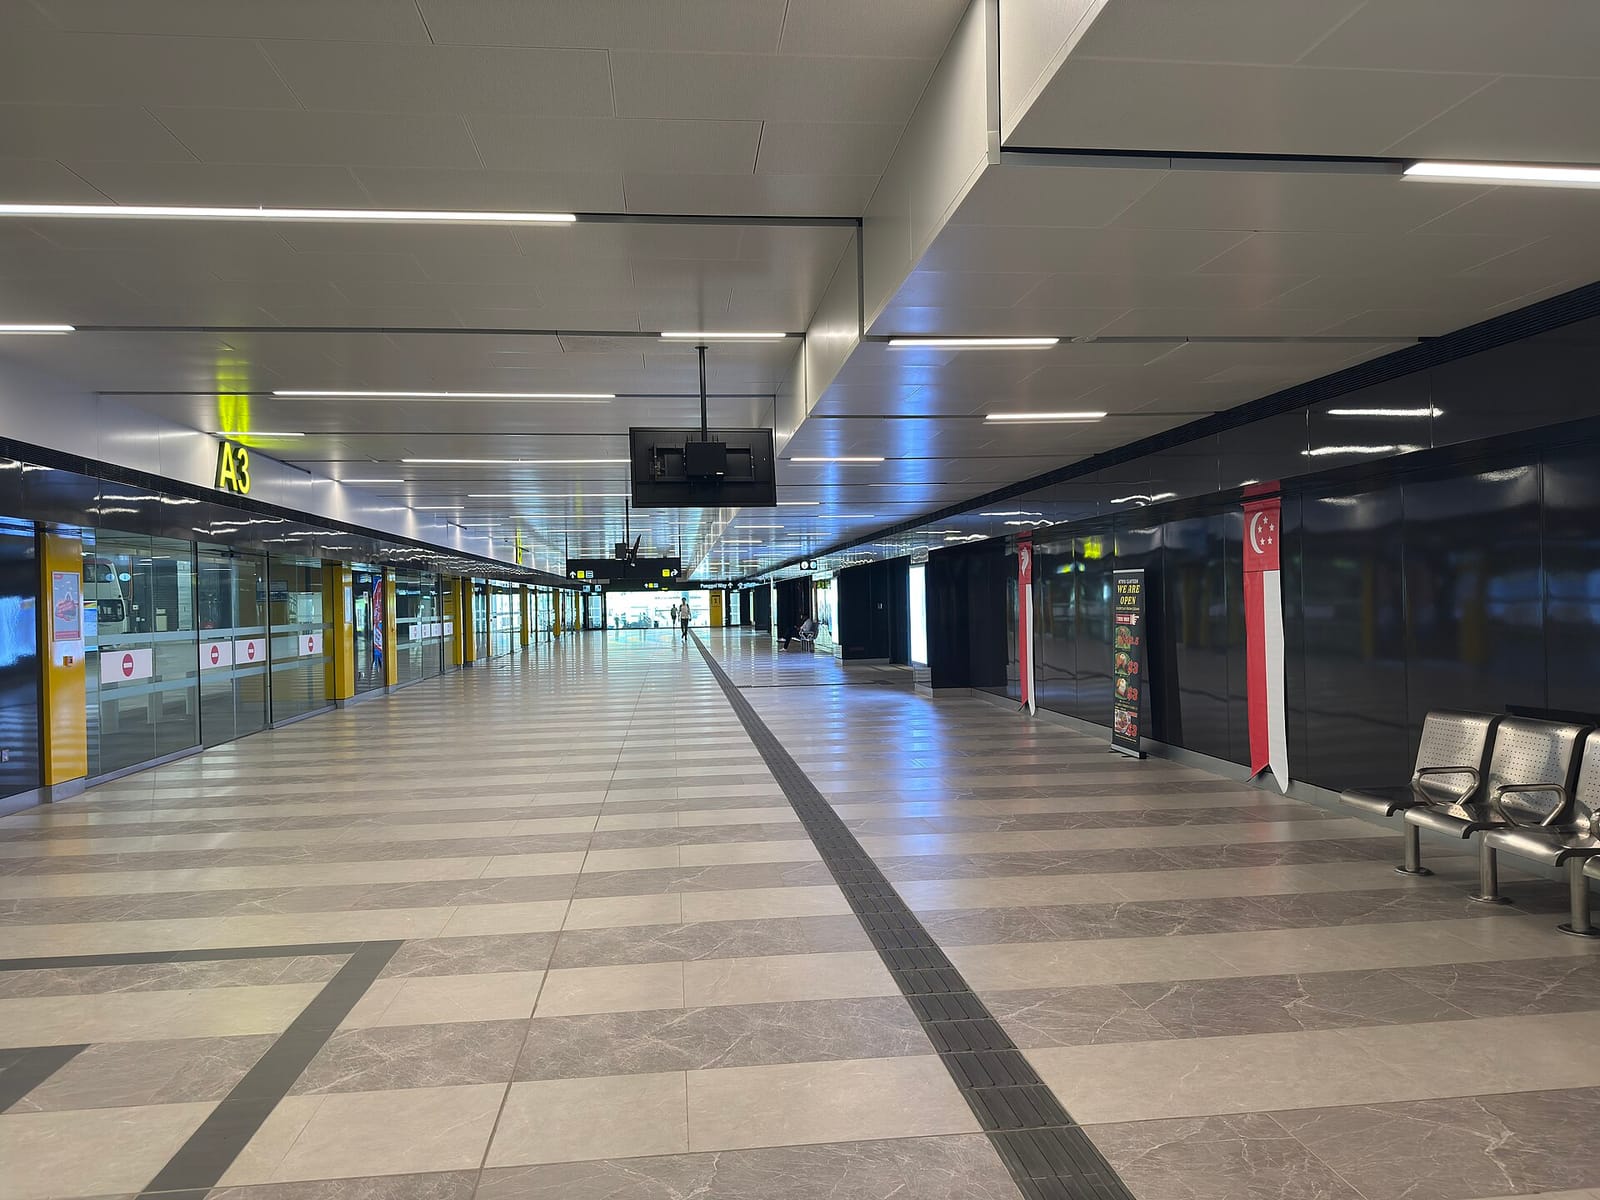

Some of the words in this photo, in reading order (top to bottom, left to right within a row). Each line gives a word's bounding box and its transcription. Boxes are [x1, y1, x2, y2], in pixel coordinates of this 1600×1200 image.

[218, 441, 251, 495] A3
[1117, 584, 1127, 594] WE
[1127, 584, 1140, 594] ARE
[1120, 596, 1136, 605] OPEN
